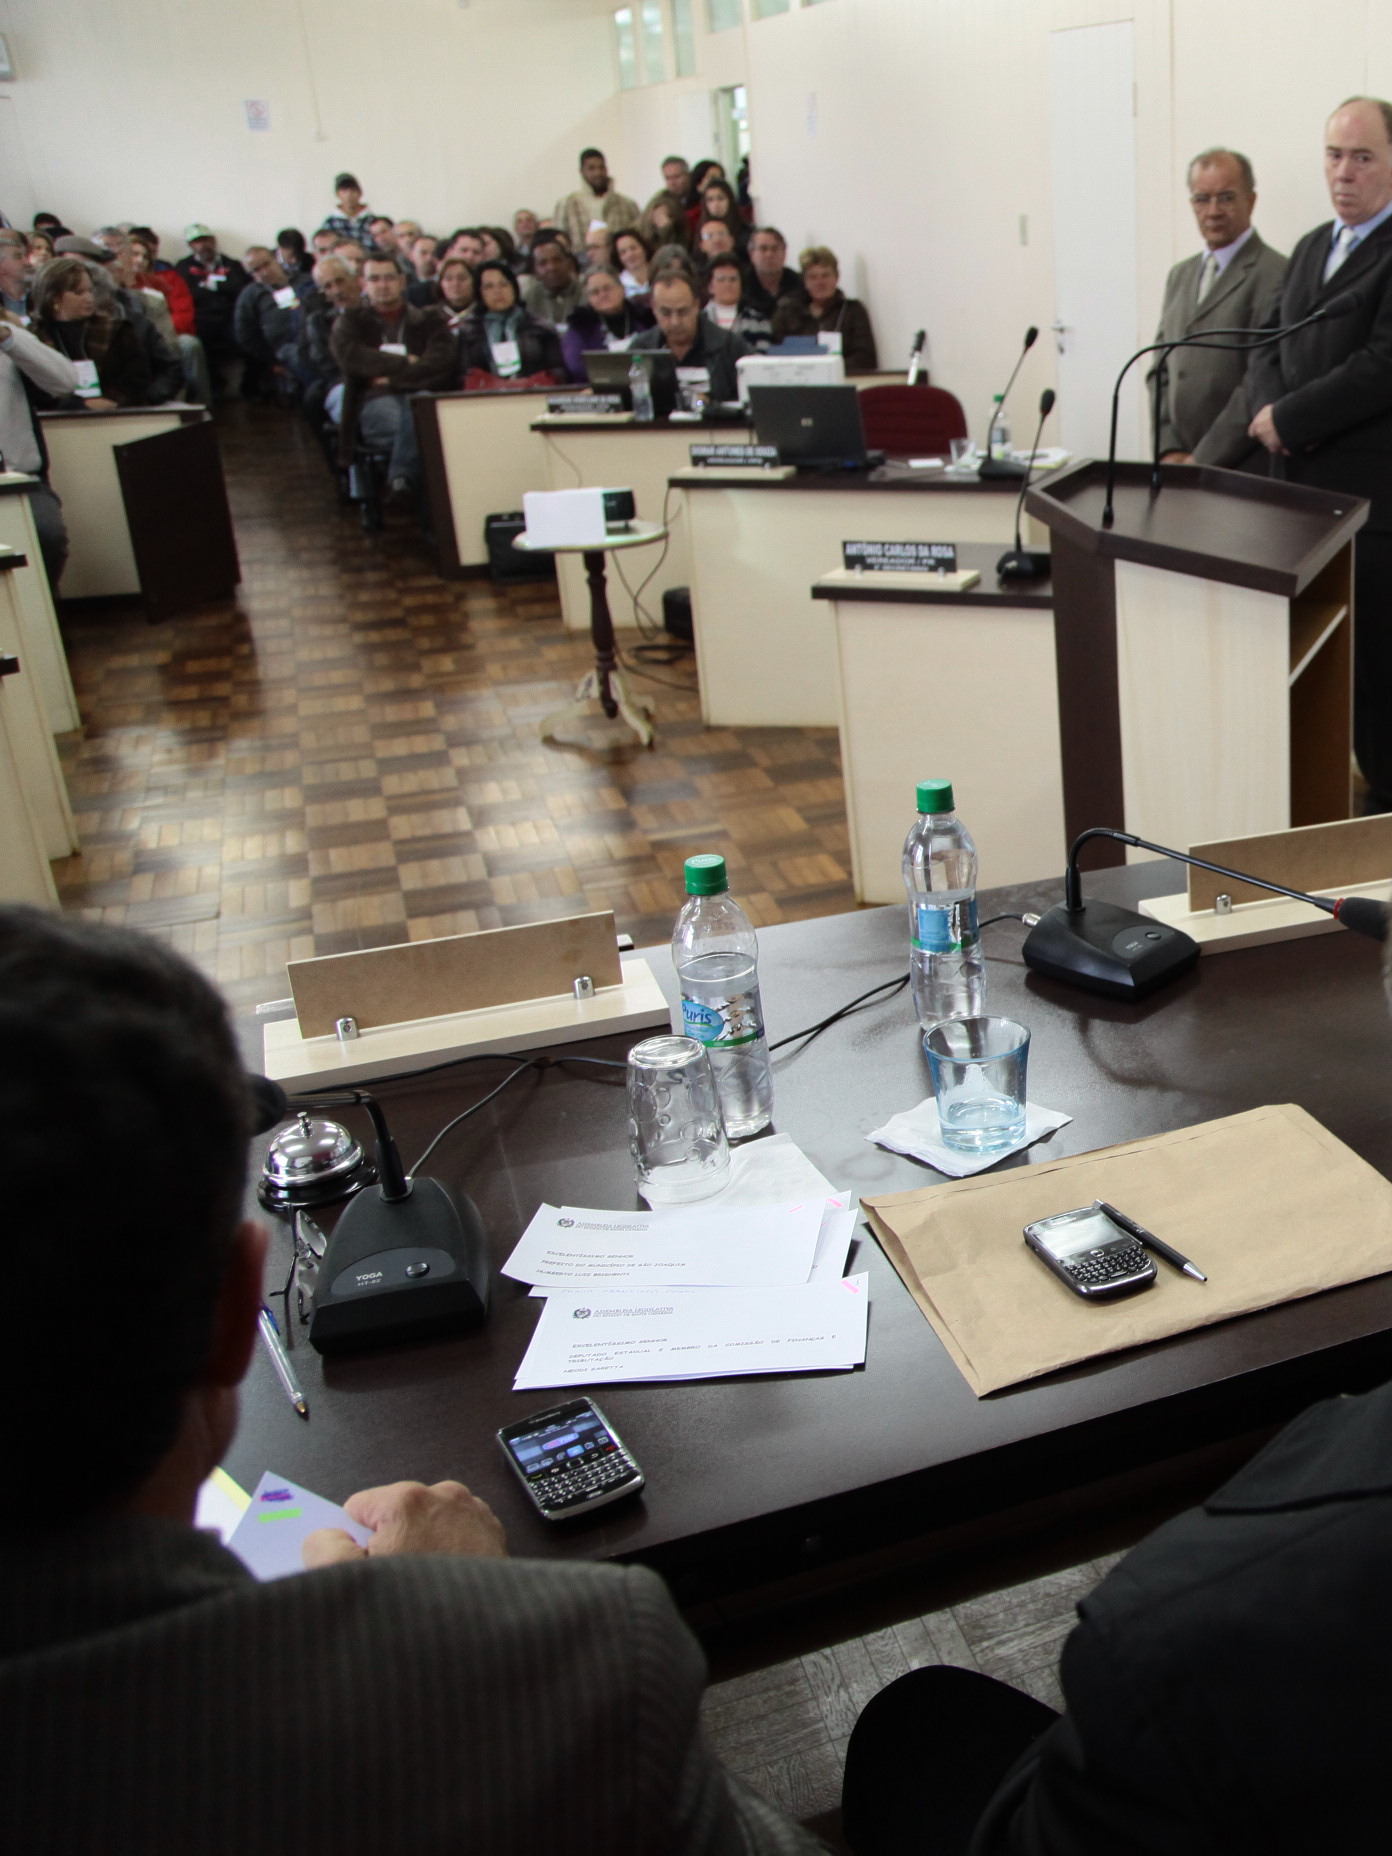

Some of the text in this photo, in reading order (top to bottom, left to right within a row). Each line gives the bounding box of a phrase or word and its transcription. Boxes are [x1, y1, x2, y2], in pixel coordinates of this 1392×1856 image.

[884, 543, 916, 557] CARLOS
[918, 544, 930, 557] DA
[930, 544, 955, 558] ROSA
[541, 1259, 574, 1267] PREFEITO
[356, 1271, 383, 1281] YOGA
[572, 1340, 636, 1348] EXCELENTÍSSIMO
[568, 1356, 614, 1364] TRIBUTAÇÃO
